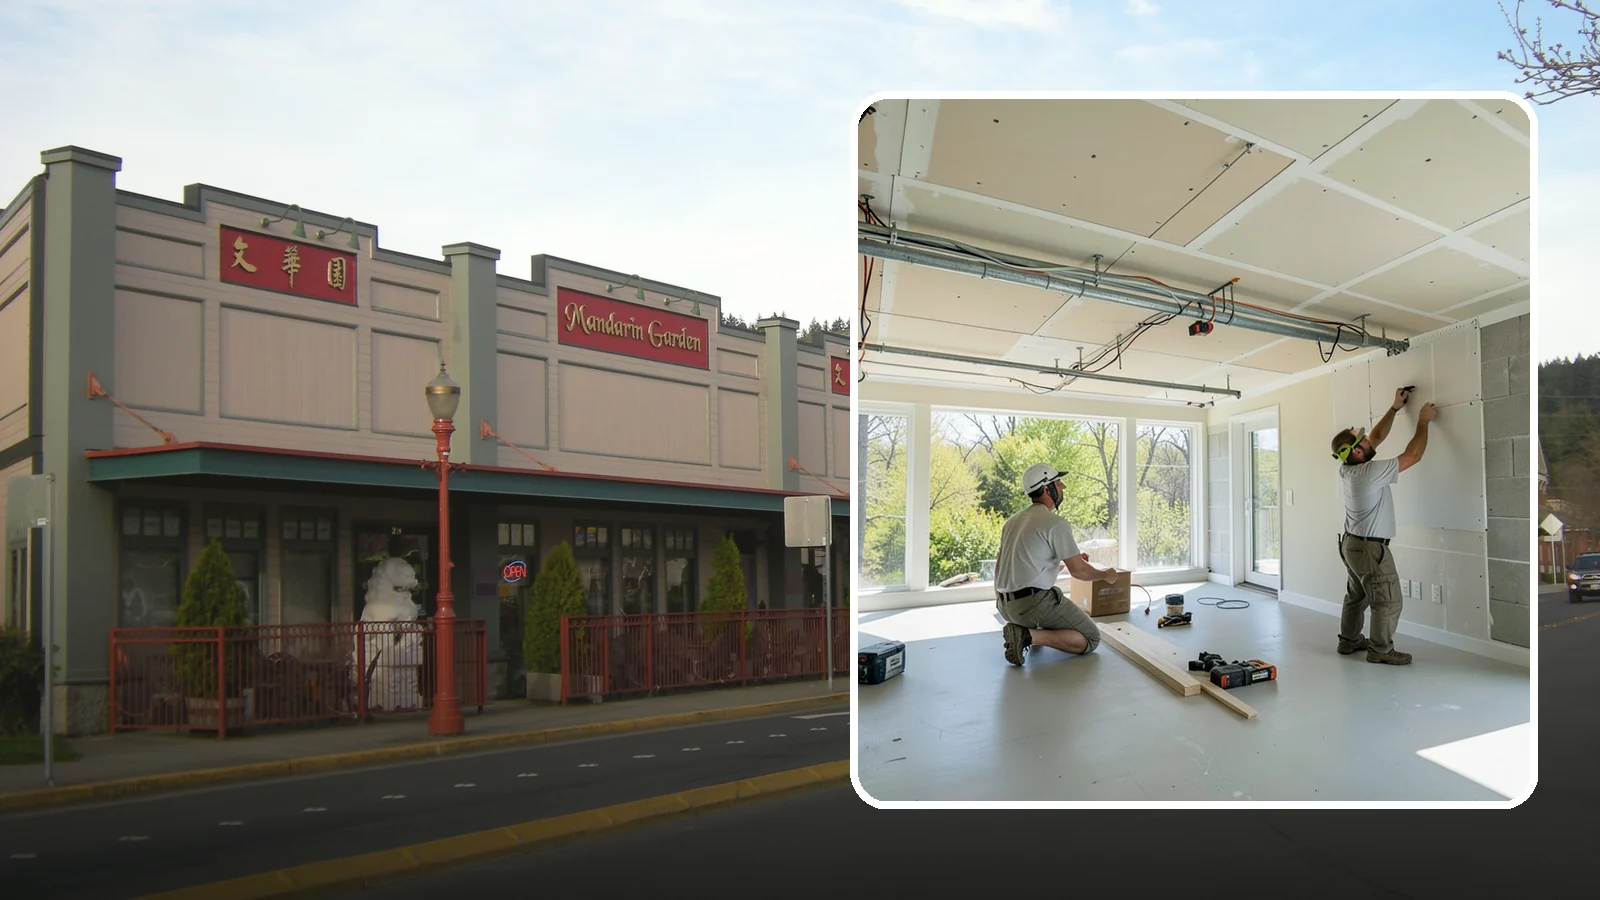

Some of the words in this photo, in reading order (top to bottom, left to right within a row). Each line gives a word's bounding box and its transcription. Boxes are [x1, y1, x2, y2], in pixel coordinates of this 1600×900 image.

[231, 236, 346, 290] 文華園
[564, 302, 644, 341] Mandarin
[648, 320, 701, 352] Garden
[503, 565, 527, 578] OPEN
